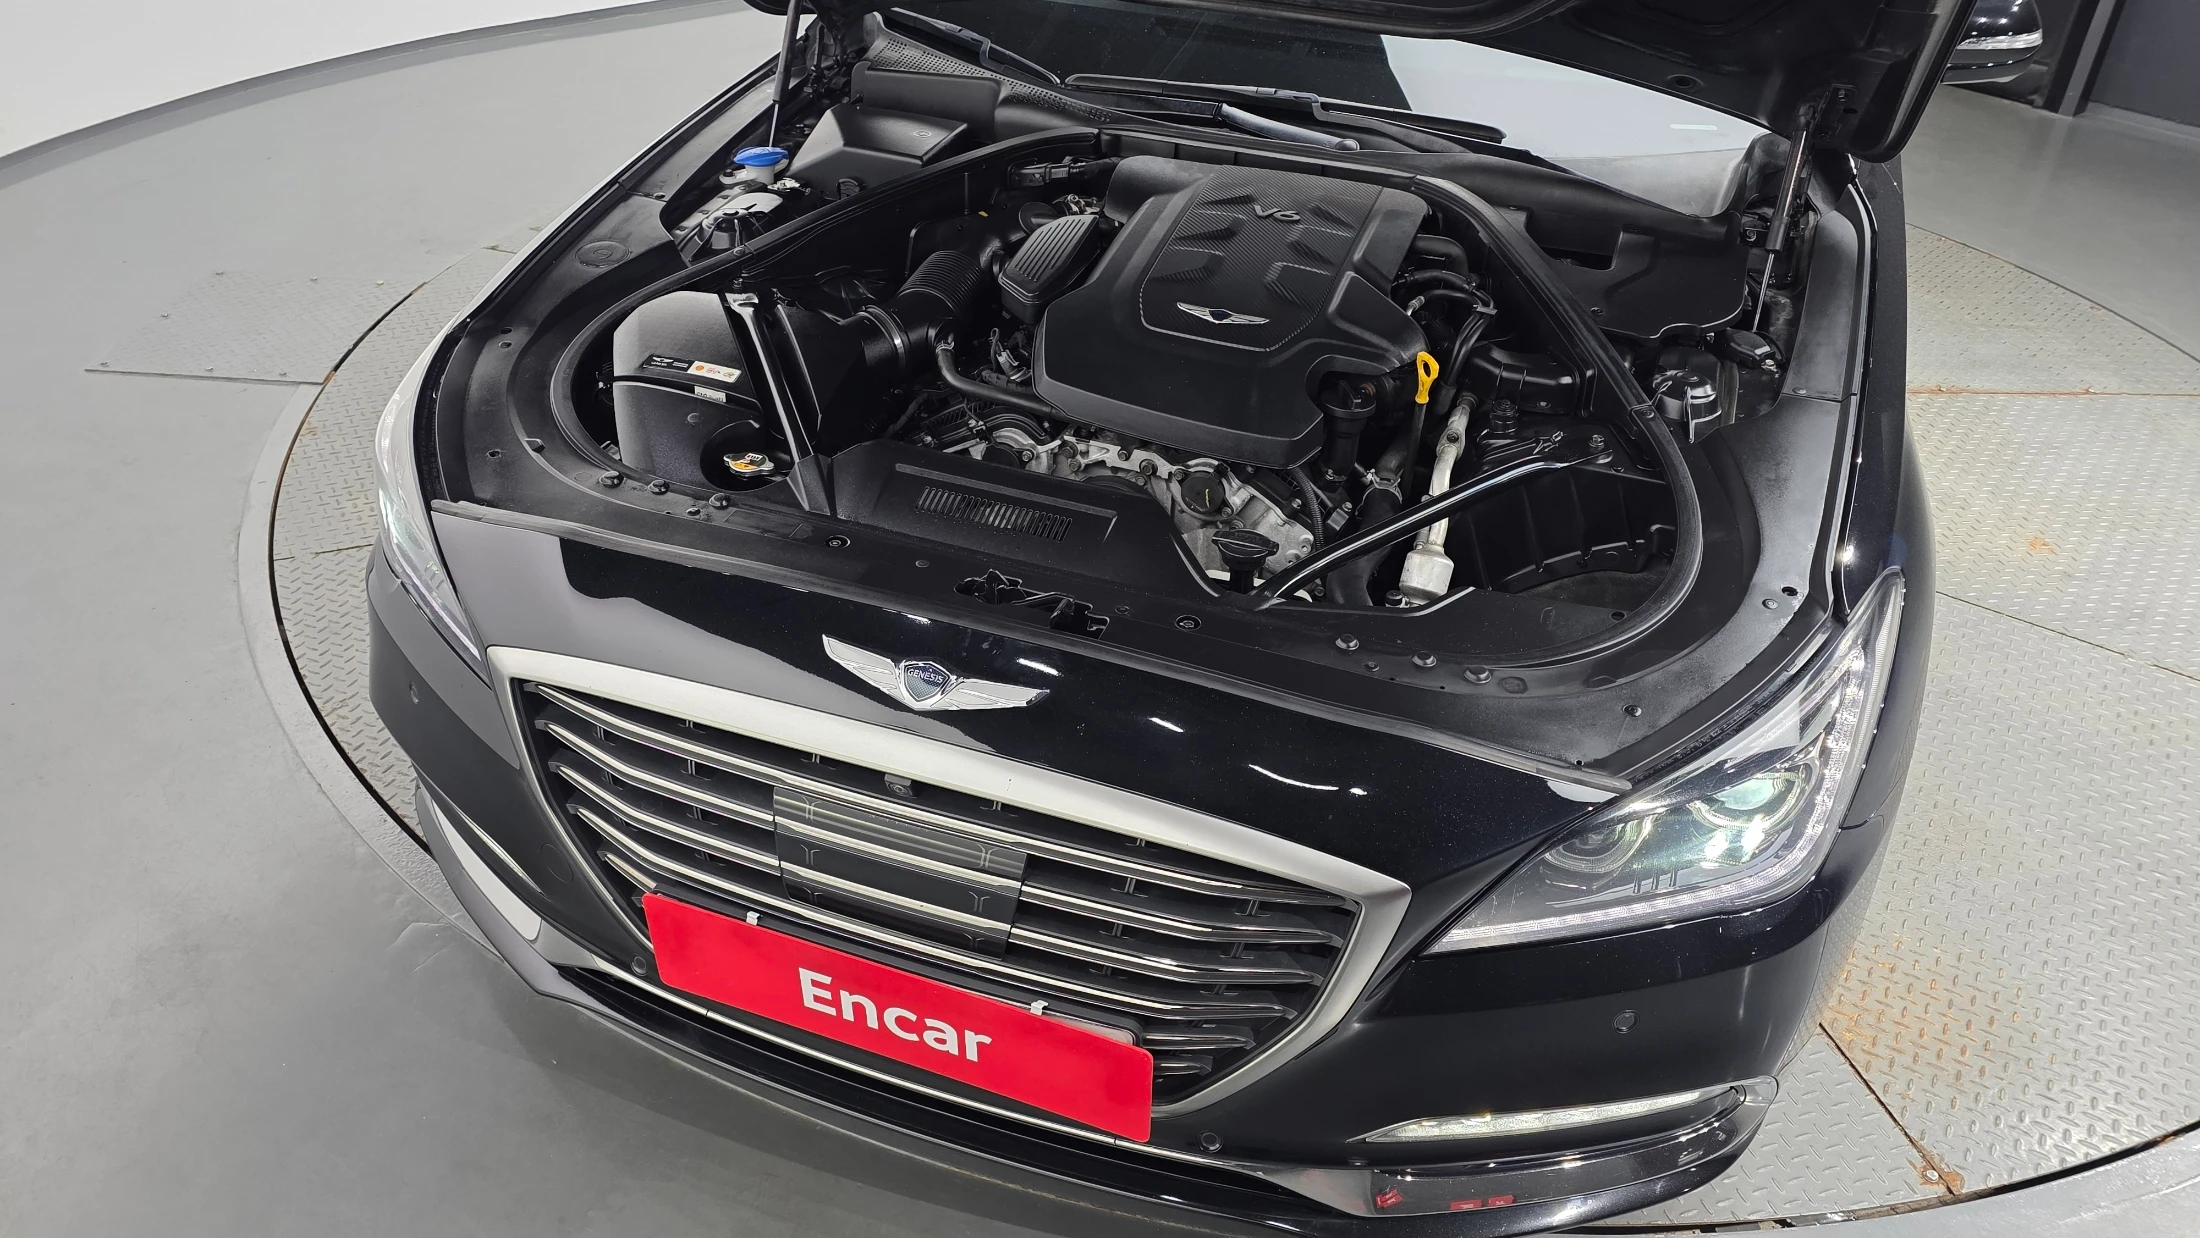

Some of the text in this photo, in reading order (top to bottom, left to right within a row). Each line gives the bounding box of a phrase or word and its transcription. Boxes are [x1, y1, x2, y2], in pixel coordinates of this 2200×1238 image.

[1254, 204, 1301, 221] V6
[908, 667, 944, 683] GENESIS
[798, 967, 992, 1062] Encar
